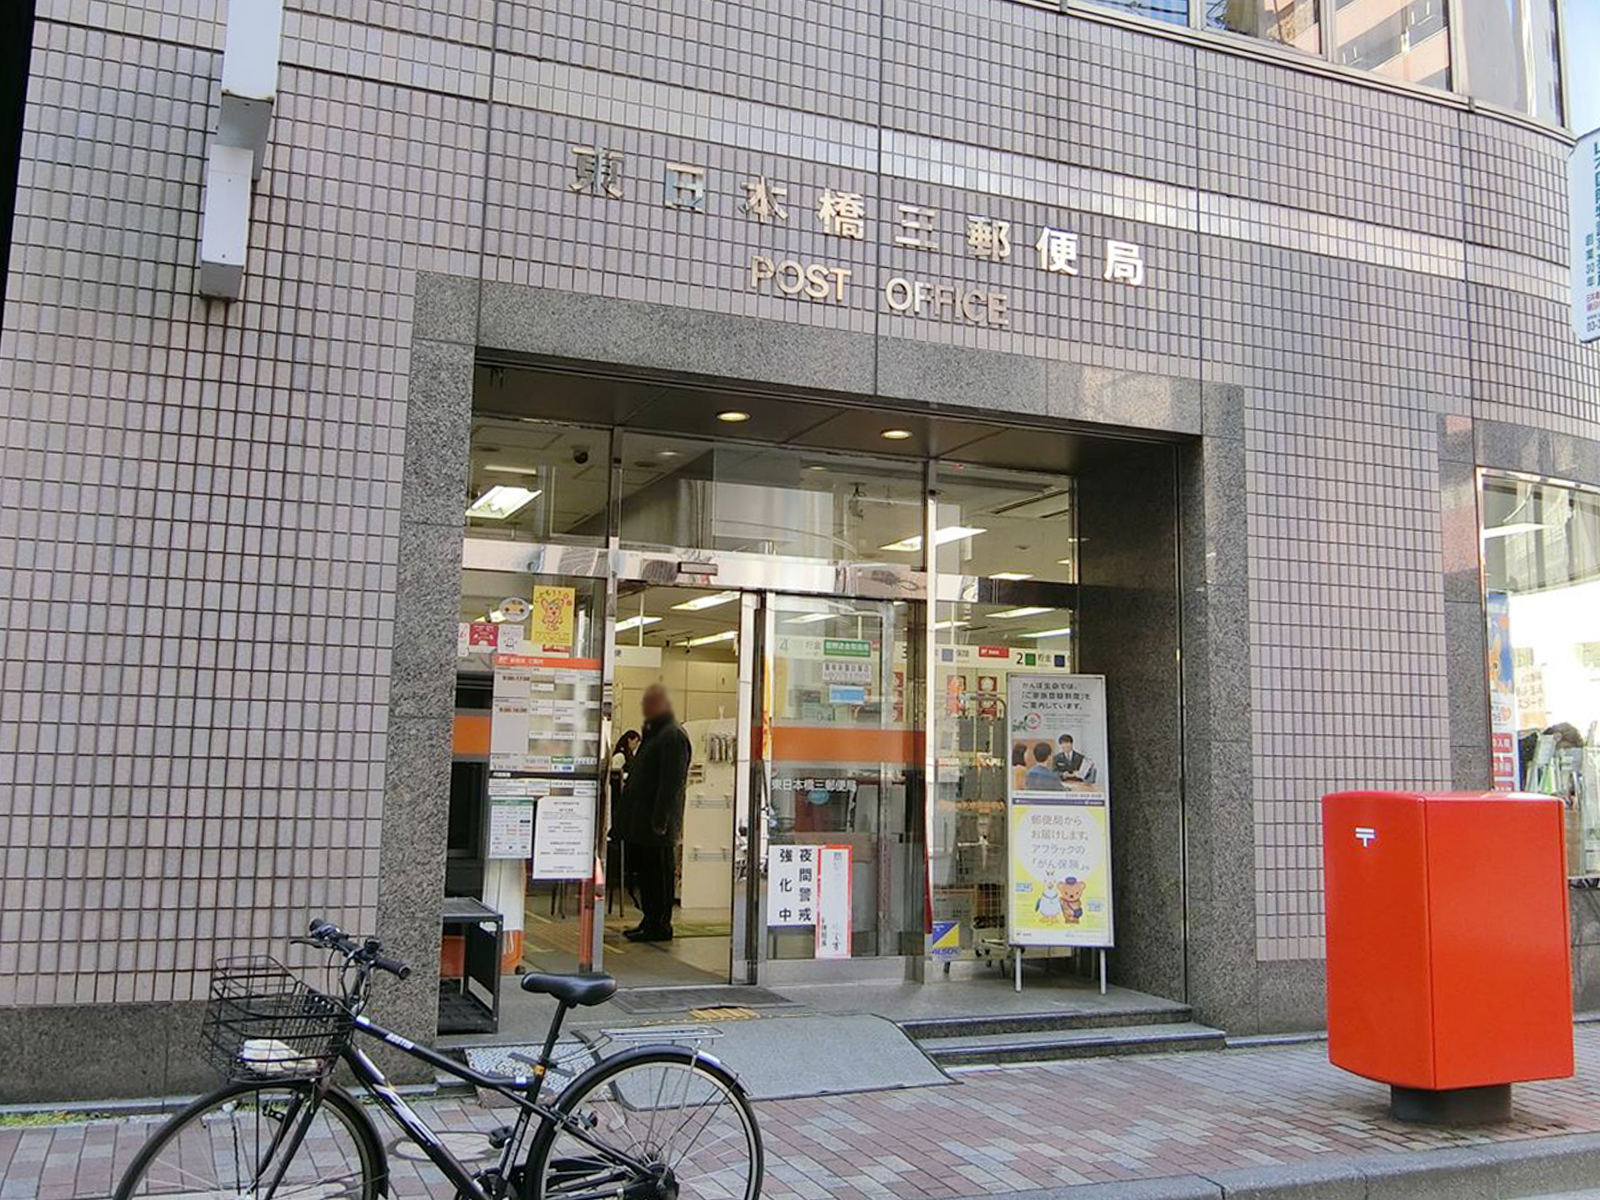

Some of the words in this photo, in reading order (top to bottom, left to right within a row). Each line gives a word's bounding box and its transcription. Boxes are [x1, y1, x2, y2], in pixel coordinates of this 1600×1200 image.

[568, 145, 1146, 287] 東日本橋三郵便局
[750, 255, 852, 303] POST
[885, 277, 1009, 326] OFFICE
[1016, 652, 1023, 665] 2
[1030, 814, 1083, 826] 郵便局から
[1031, 844, 1086, 855] アフラックの
[779, 848, 794, 922] 強化中
[798, 848, 813, 922] 夜間警戒
